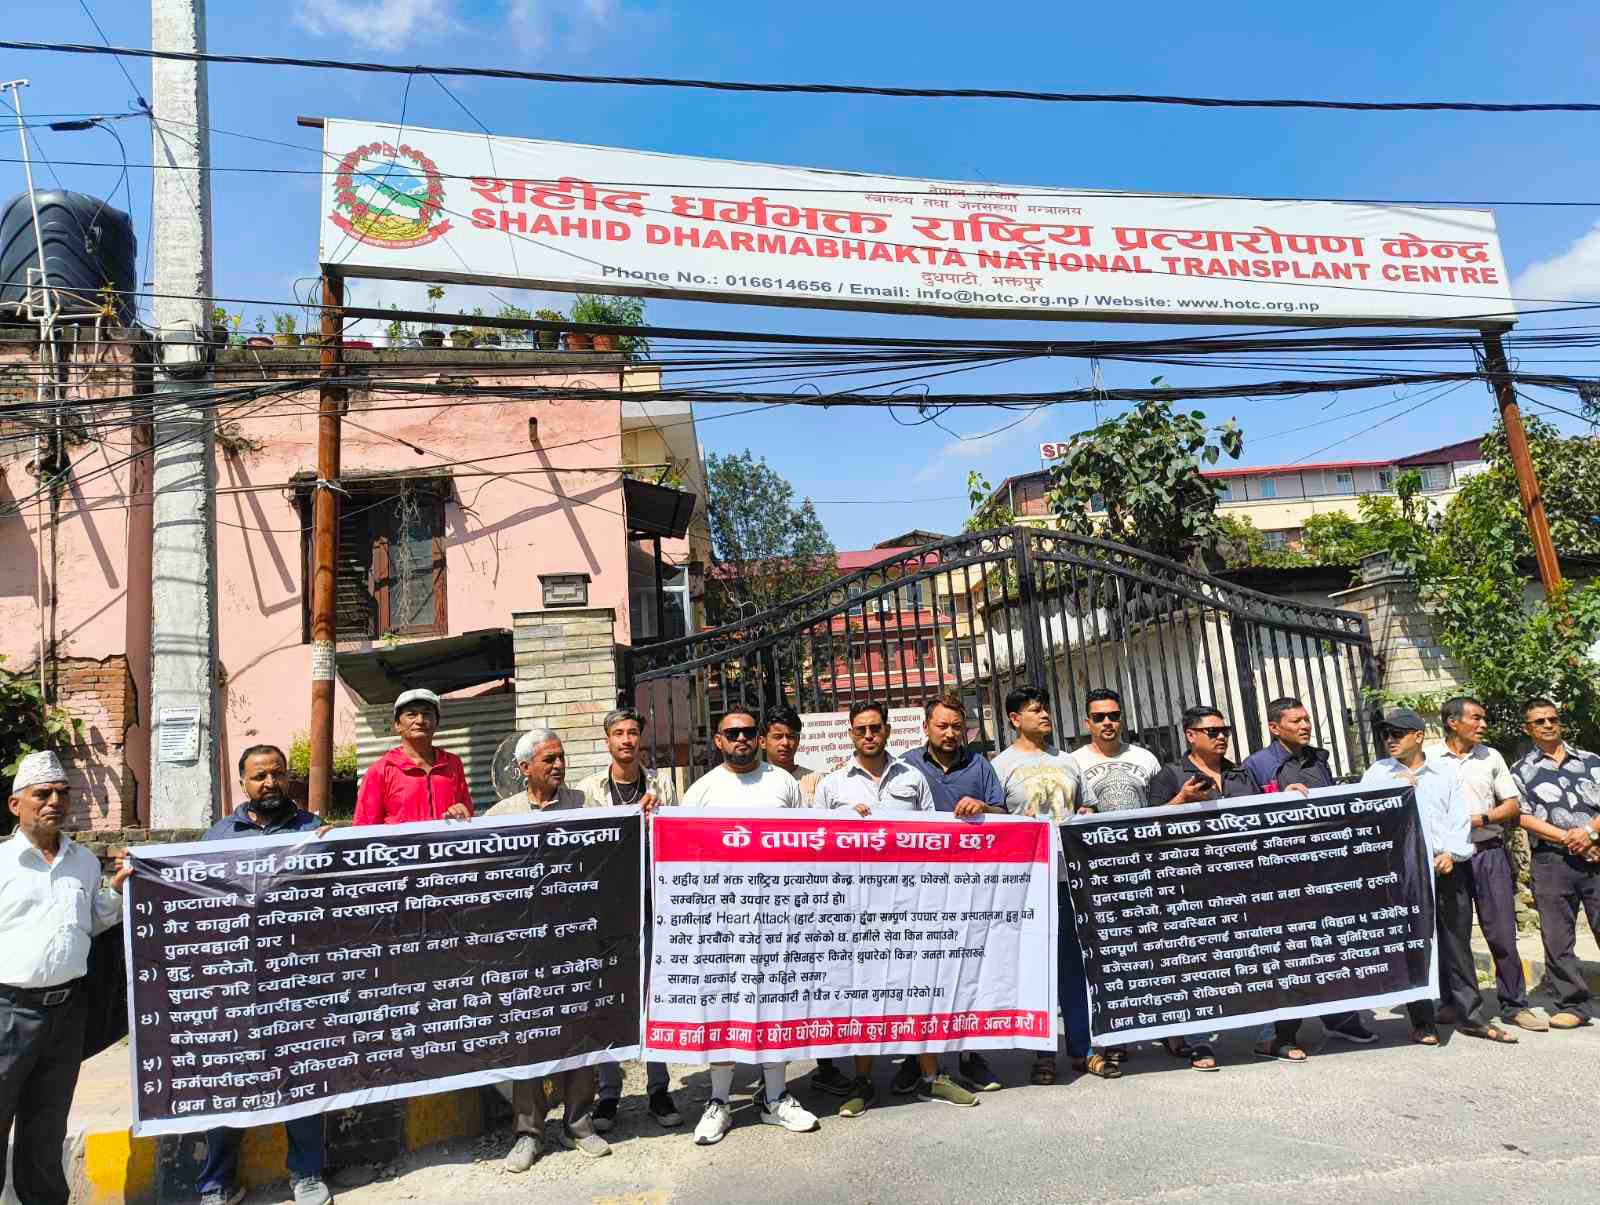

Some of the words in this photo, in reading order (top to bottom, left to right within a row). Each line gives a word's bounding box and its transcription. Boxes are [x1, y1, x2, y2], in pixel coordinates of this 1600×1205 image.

[469, 176, 650, 218] शहीद
[671, 194, 893, 234] धर्मभक्त
[911, 212, 1094, 251] राष्ट्रिय
[1111, 225, 1365, 257] प्रत्यारोपण
[1380, 232, 1489, 263] केन्द्र
[924, 198, 949, 208] तथा
[1028, 206, 1082, 216] मन्त्रालय
[471, 208, 631, 241] SHAHID
[646, 223, 967, 267] DHARMABHAKTA
[977, 249, 1152, 273] NATIONAL
[1161, 256, 1371, 281] TRANSPLANT
[1381, 264, 1499, 284] CENTRE
[602, 264, 669, 282] Phone
[678, 271, 718, 285] No.:
[726, 275, 832, 293] 016614656
[850, 283, 910, 297] Email:
[917, 287, 1079, 307] info@hotc.org.np
[1094, 295, 1171, 308] Website:
[1177, 299, 1319, 312] www.hotc.org.np
[992, 276, 1043, 291] भक्तपुर
[1082, 827, 1129, 846] शहिद
[1133, 823, 1162, 840] धर्म
[1167, 820, 1201, 837] भक्त
[1207, 813, 1260, 832] राष्ट्रिय
[1265, 803, 1346, 827] प्रत्यारोपण
[1351, 795, 1403, 814] केन्द्रमा
[722, 825, 752, 848] के
[836, 828, 887, 850] लाई
[896, 832, 952, 850] थाहा
[160, 861, 227, 883] शहिद
[236, 854, 277, 875] धर्म
[285, 849, 334, 870] भक्त
[344, 843, 419, 867] राष्ट्रिय
[429, 834, 540, 860] प्रत्यारोपण
[547, 827, 622, 847] केन्द्रमा
[163, 892, 240, 913] भ्रष्टाचारी
[265, 884, 325, 904] अयोग्य
[485, 862, 544, 881] कारवाही
[672, 872, 699, 886] शहीद
[723, 874, 743, 885] भक्त
[748, 872, 780, 888] राष्ट्रिय
[783, 872, 828, 887] प्रत्यारोपण
[1114, 869, 1151, 884] कानुनी
[1156, 864, 1202, 880] तरिकाले
[163, 920, 189, 935] गैर
[196, 914, 251, 935] कानुनी
[258, 908, 325, 927] तरिकाले
[671, 913, 712, 925] हामीलाई
[716, 911, 750, 924] Heart
[753, 912, 790, 924] Attack
[327, 943, 381, 962] फोक्सो
[389, 942, 419, 956] तथा
[427, 936, 458, 952] नशा
[465, 924, 548, 946] सेवाहरुलाई
[805, 931, 834, 944] सकेको
[904, 930, 923, 941] किन
[221, 981, 251, 998] गरि
[258, 971, 336, 993] व्यवस्थित
[169, 1007, 217, 1026] सम्पूर्ण
[225, 991, 351, 1025] कर्मचारीहरुलाई
[358, 982, 426, 1000] कार्यालय
[432, 976, 474, 991] समय
[247, 1020, 324, 1041] अवधिभर
[427, 999, 457, 1013] सेवा
[463, 992, 492, 1009] दिने
[498, 982, 564, 1006] सुनिश्चित
[200, 1048, 266, 1069] प्रकारका
[274, 1035, 346, 1058] अस्पताल
[353, 1029, 384, 1043] भित्र
[422, 1014, 494, 1035] सामाजिक
[650, 1027, 674, 1042] आज
[171, 1066, 283, 1091] कर्मचारीहरुको
[289, 1050, 359, 1077] रोकिएको
[410, 1040, 456, 1059] सुविधा
[212, 1094, 237, 1110] ऐन
